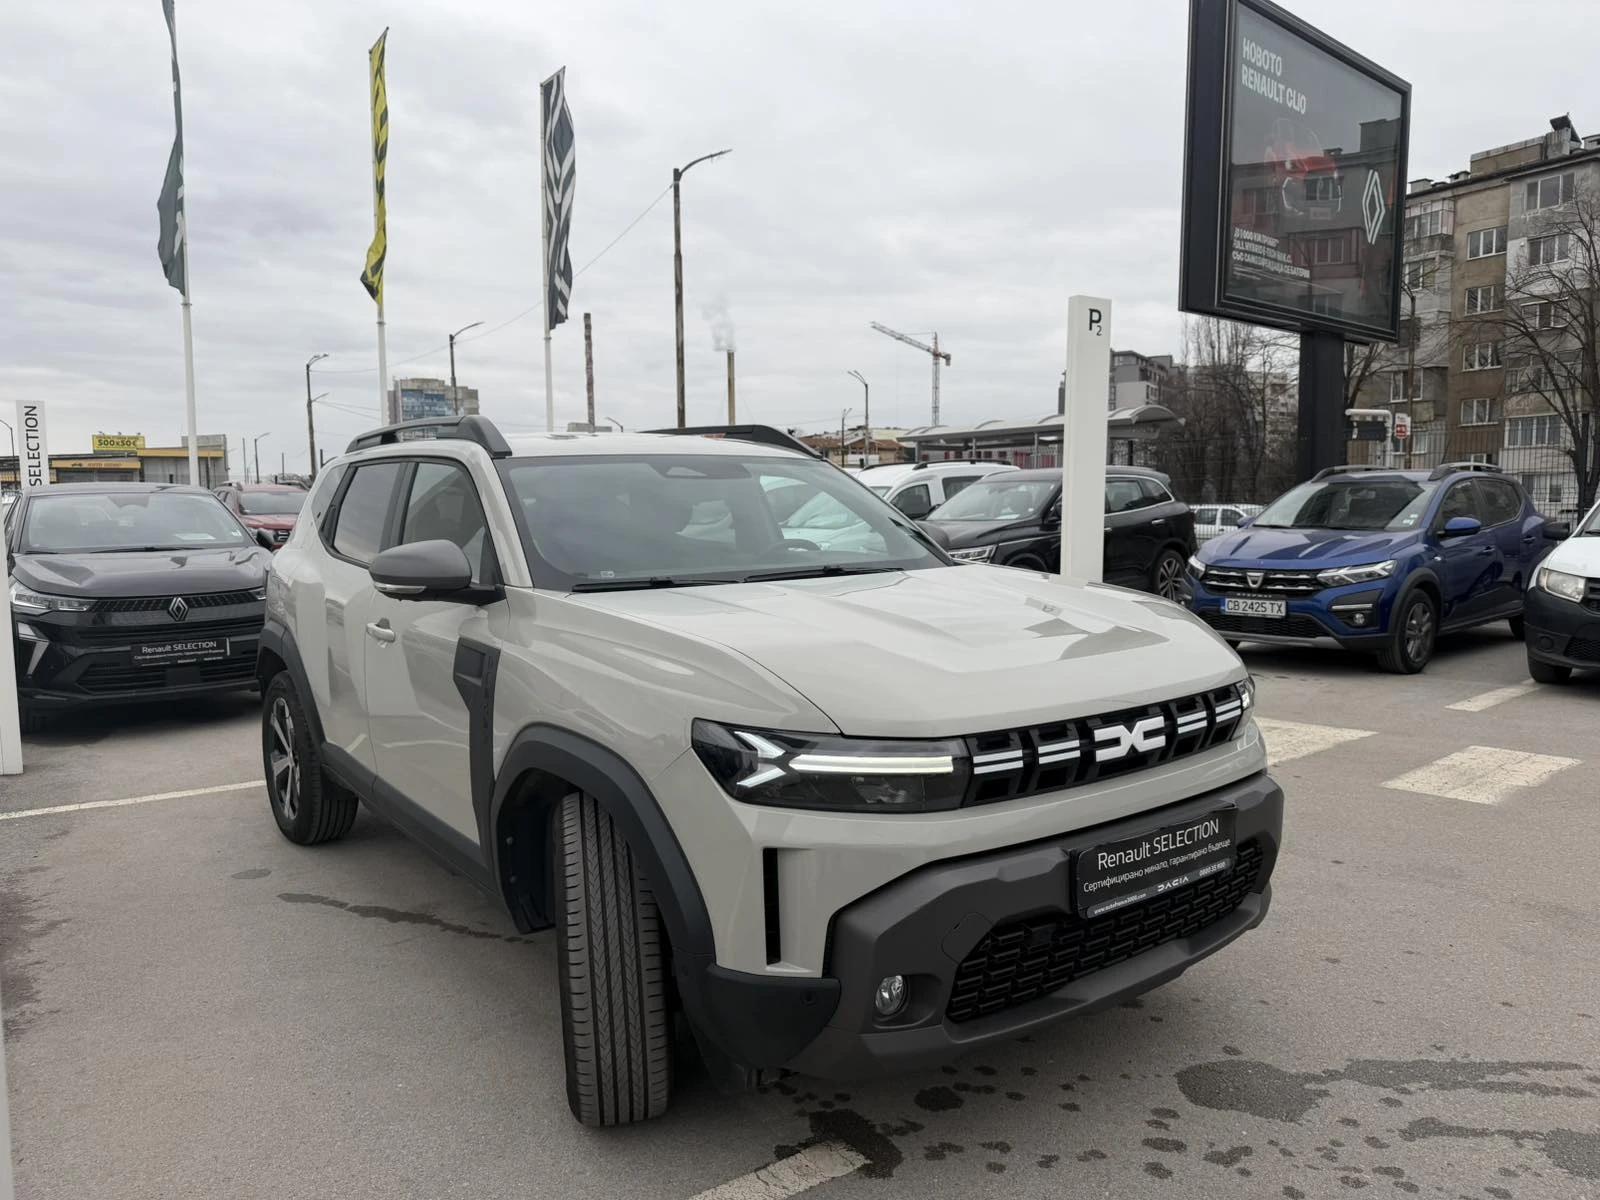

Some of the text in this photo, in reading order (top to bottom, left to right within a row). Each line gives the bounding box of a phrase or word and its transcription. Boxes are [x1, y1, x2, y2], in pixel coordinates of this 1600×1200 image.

[1242, 37, 1282, 77] НОВОТО
[1242, 63, 1306, 115] RENAULT CLIO
[24, 405, 43, 487] SELECTION
[1227, 600, 1283, 614] CB 2425 TX
[142, 641, 217, 654] Renault SELECTION
[1083, 868, 1143, 893] Сертифицирано
[1169, 846, 1208, 867] гарантирано
[1207, 838, 1231, 855] бъдеще
[1098, 818, 1219, 871] Renault SELECTION
[1157, 876, 1189, 892] DACIA
